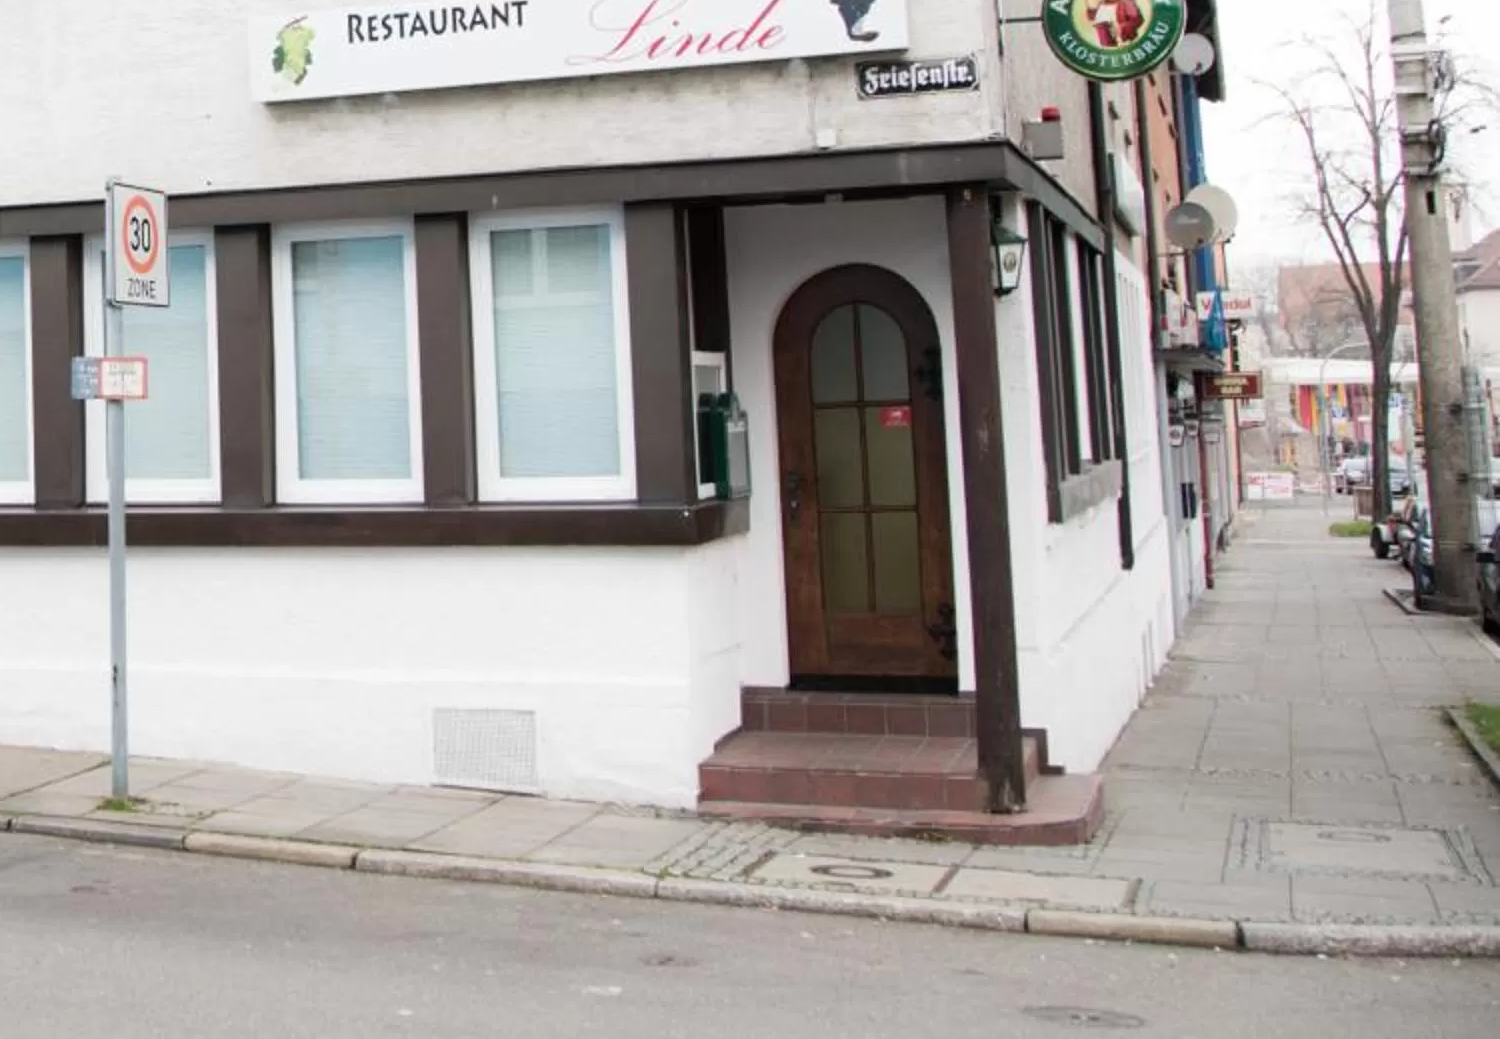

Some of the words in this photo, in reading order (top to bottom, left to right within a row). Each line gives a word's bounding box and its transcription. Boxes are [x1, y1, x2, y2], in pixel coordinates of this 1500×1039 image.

[347, 0, 528, 44] RESTAURANT
[130, 216, 151, 253] 30
[127, 277, 157, 300] ZONE
